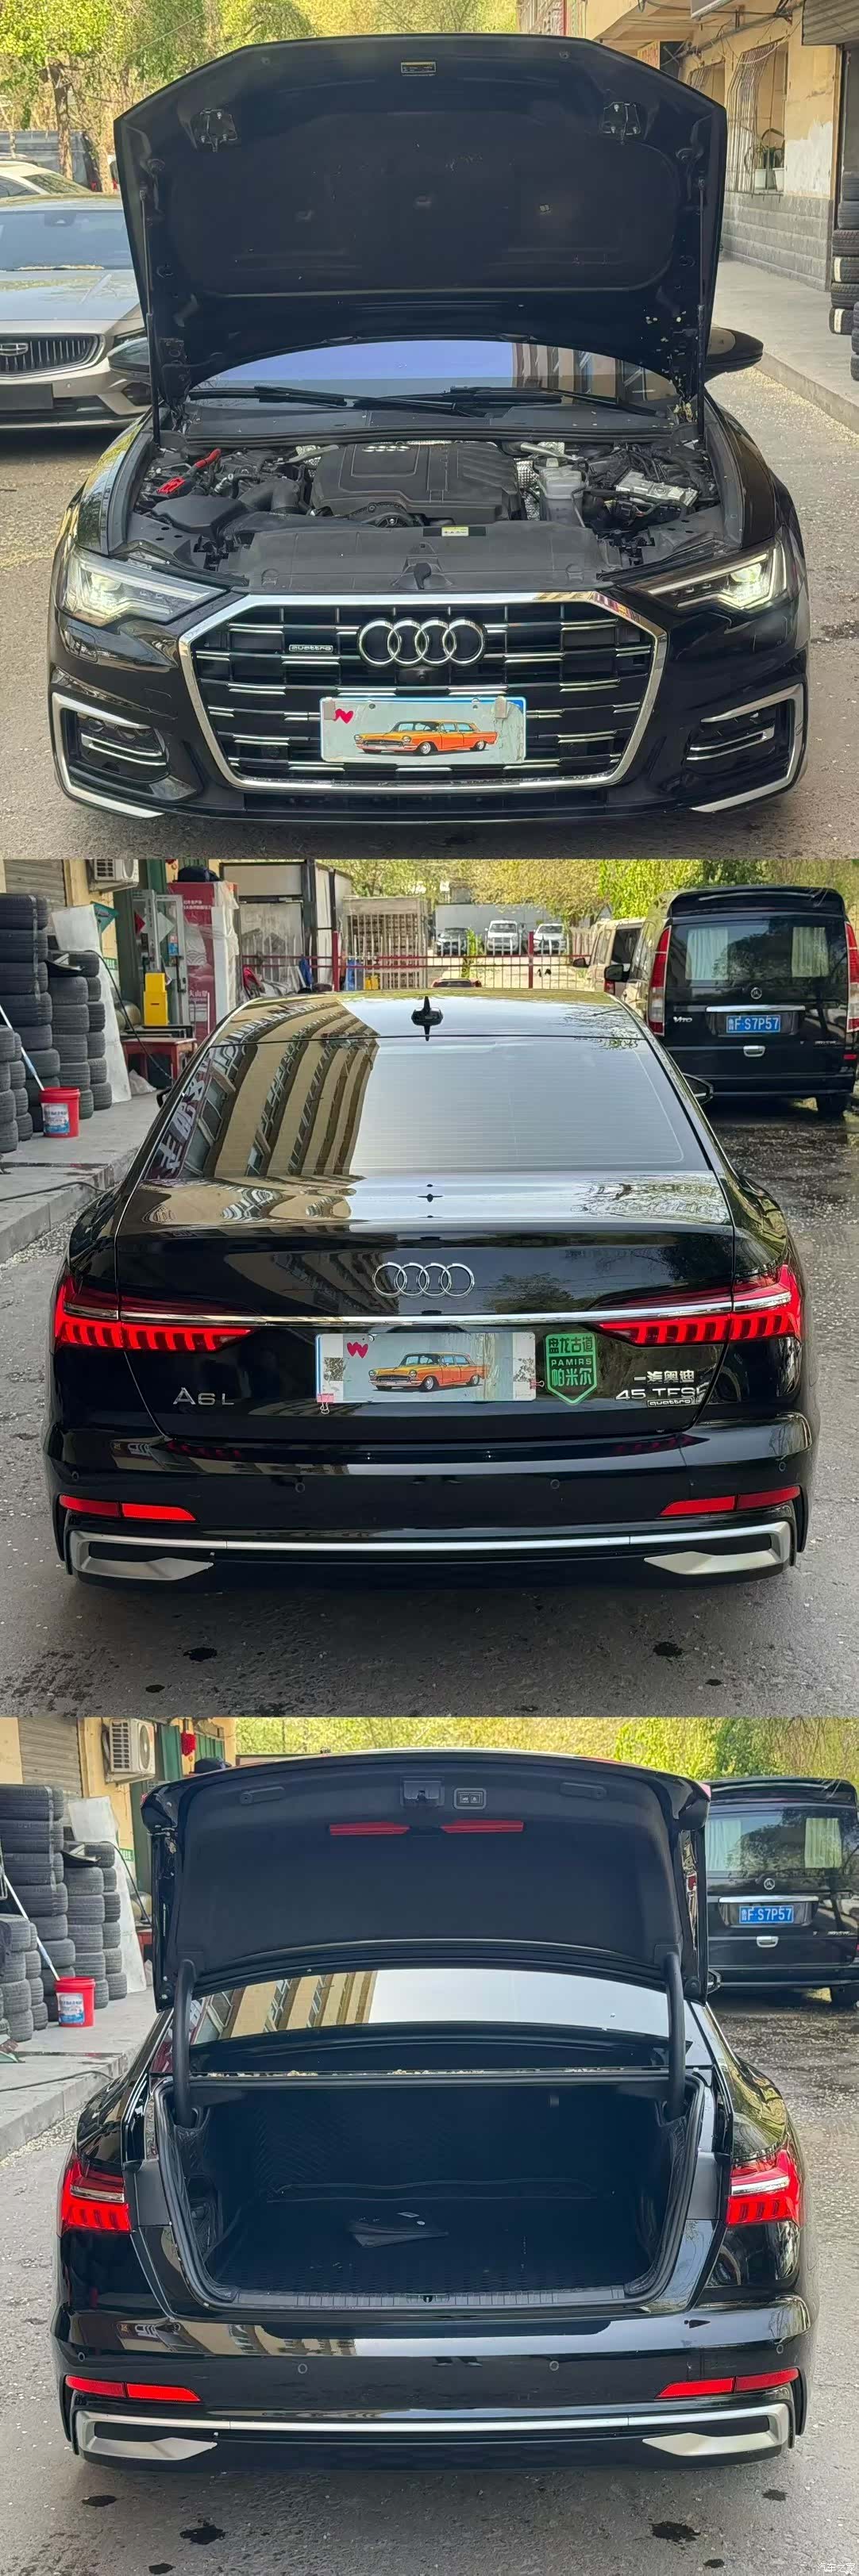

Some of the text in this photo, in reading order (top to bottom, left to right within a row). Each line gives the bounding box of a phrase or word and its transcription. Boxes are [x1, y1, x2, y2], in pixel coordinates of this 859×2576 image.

[549, 1337, 593, 1354] 盘龙古道
[551, 1368, 592, 1386] 帕米尔
[634, 1370, 695, 1384] 一汽奥迪
[615, 1389, 647, 1401] 45
